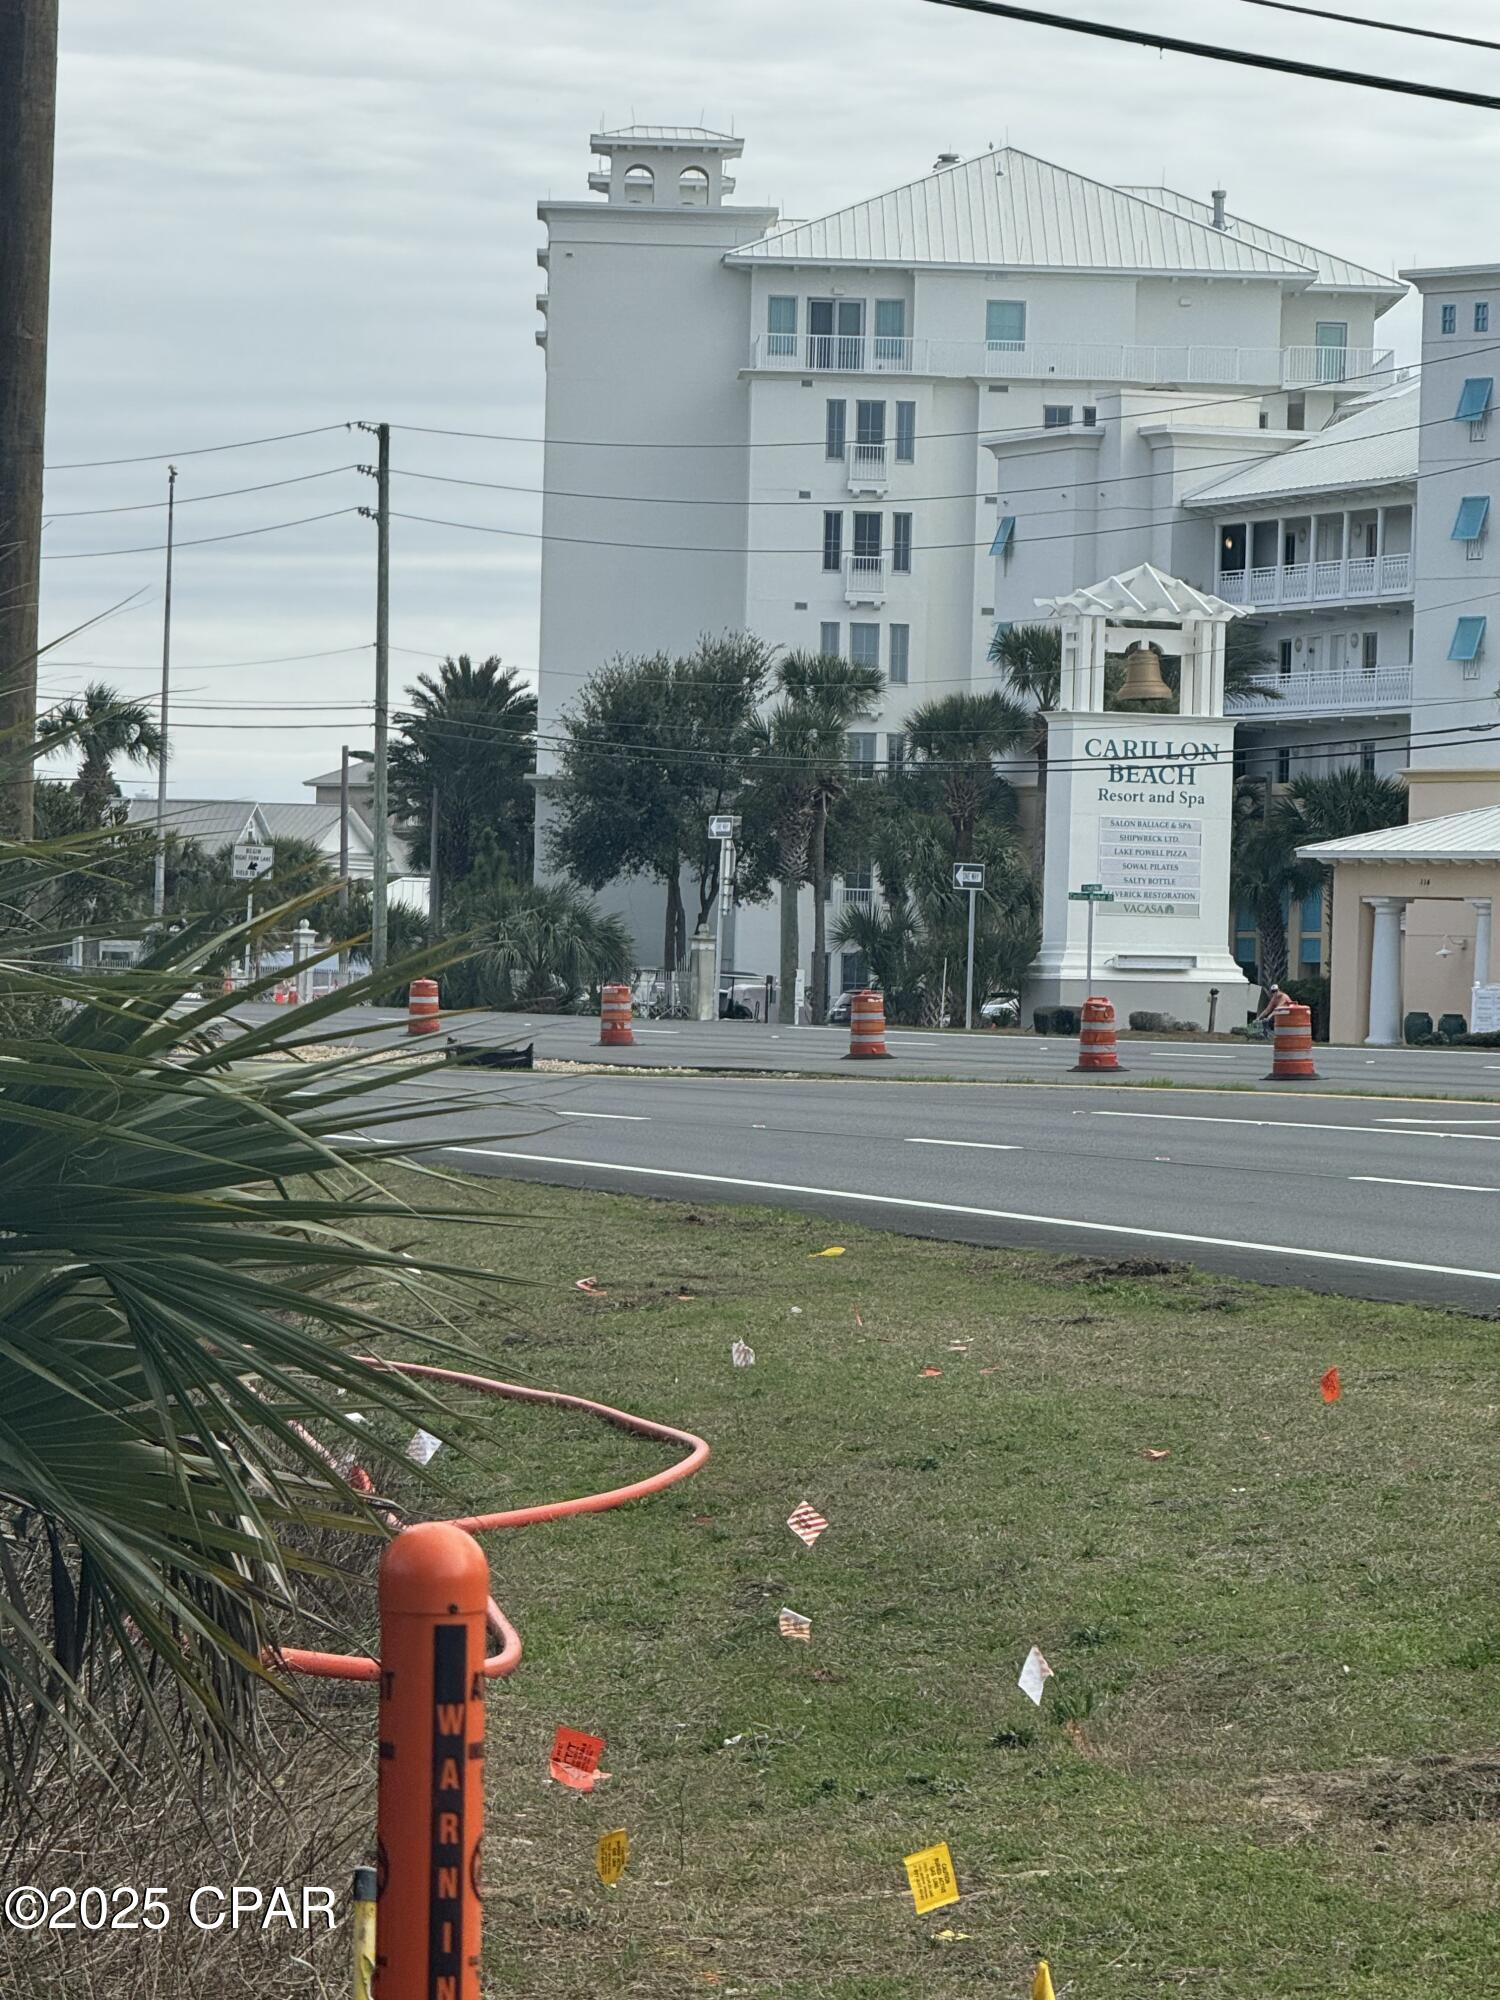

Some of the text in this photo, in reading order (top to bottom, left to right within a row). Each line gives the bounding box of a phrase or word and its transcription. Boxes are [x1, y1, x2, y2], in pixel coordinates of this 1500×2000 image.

[1084, 738, 1220, 761] CARILLON
[1108, 763, 1197, 786] BEACH
[1098, 787, 1205, 808] Resort and Spa
[1119, 834, 1162, 843] SHIPWRECK
[1114, 848, 1133, 856] LAKE
[1135, 849, 1166, 857] POWELL
[1122, 862, 1179, 871] SOWAL PILATES
[1123, 877, 1176, 886] SALTY BOTTLE
[1143, 890, 1196, 900] RESTORATION
[1123, 904, 1165, 914] VACASA
